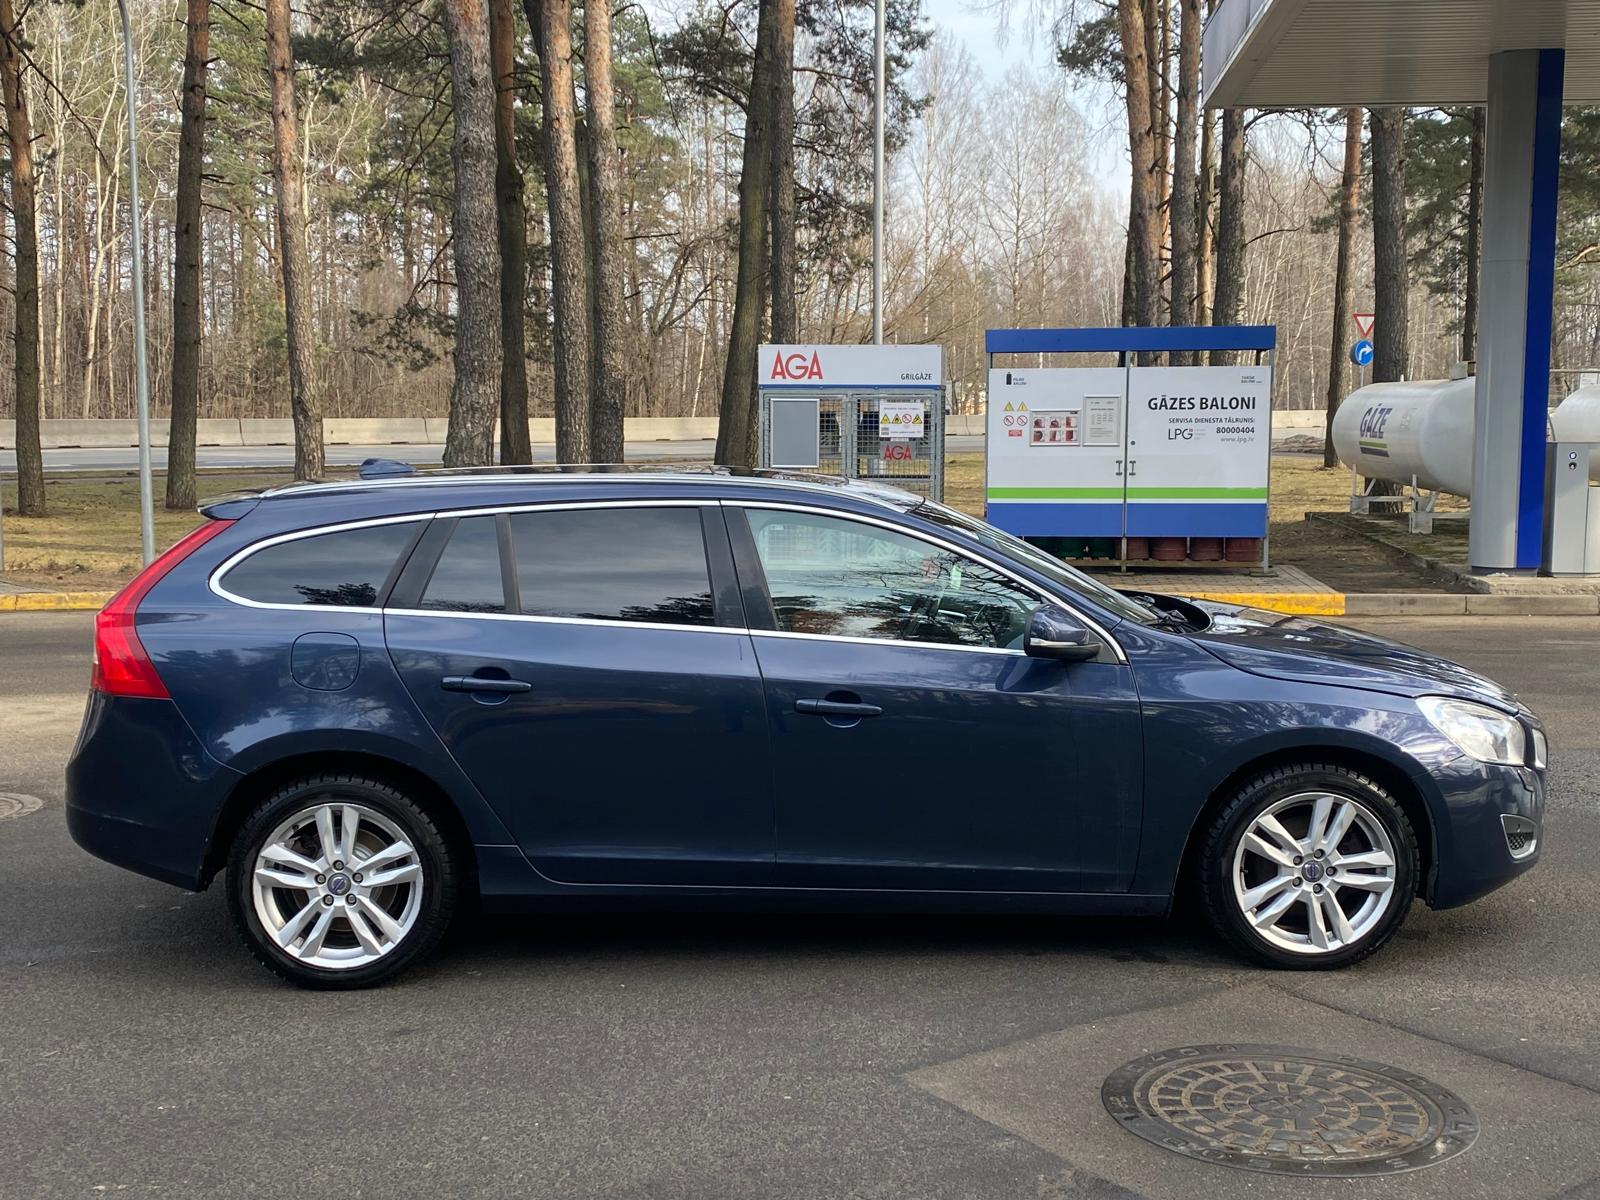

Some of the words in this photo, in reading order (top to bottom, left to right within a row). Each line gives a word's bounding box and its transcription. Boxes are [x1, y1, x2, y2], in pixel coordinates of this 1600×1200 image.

[772, 350, 823, 379] AGA
[1148, 395, 1195, 410] GĀZES
[1200, 396, 1256, 410] BALONI
[1168, 428, 1193, 440] LPG
[1216, 426, 1255, 434] 80000404
[884, 445, 912, 460] AGA
